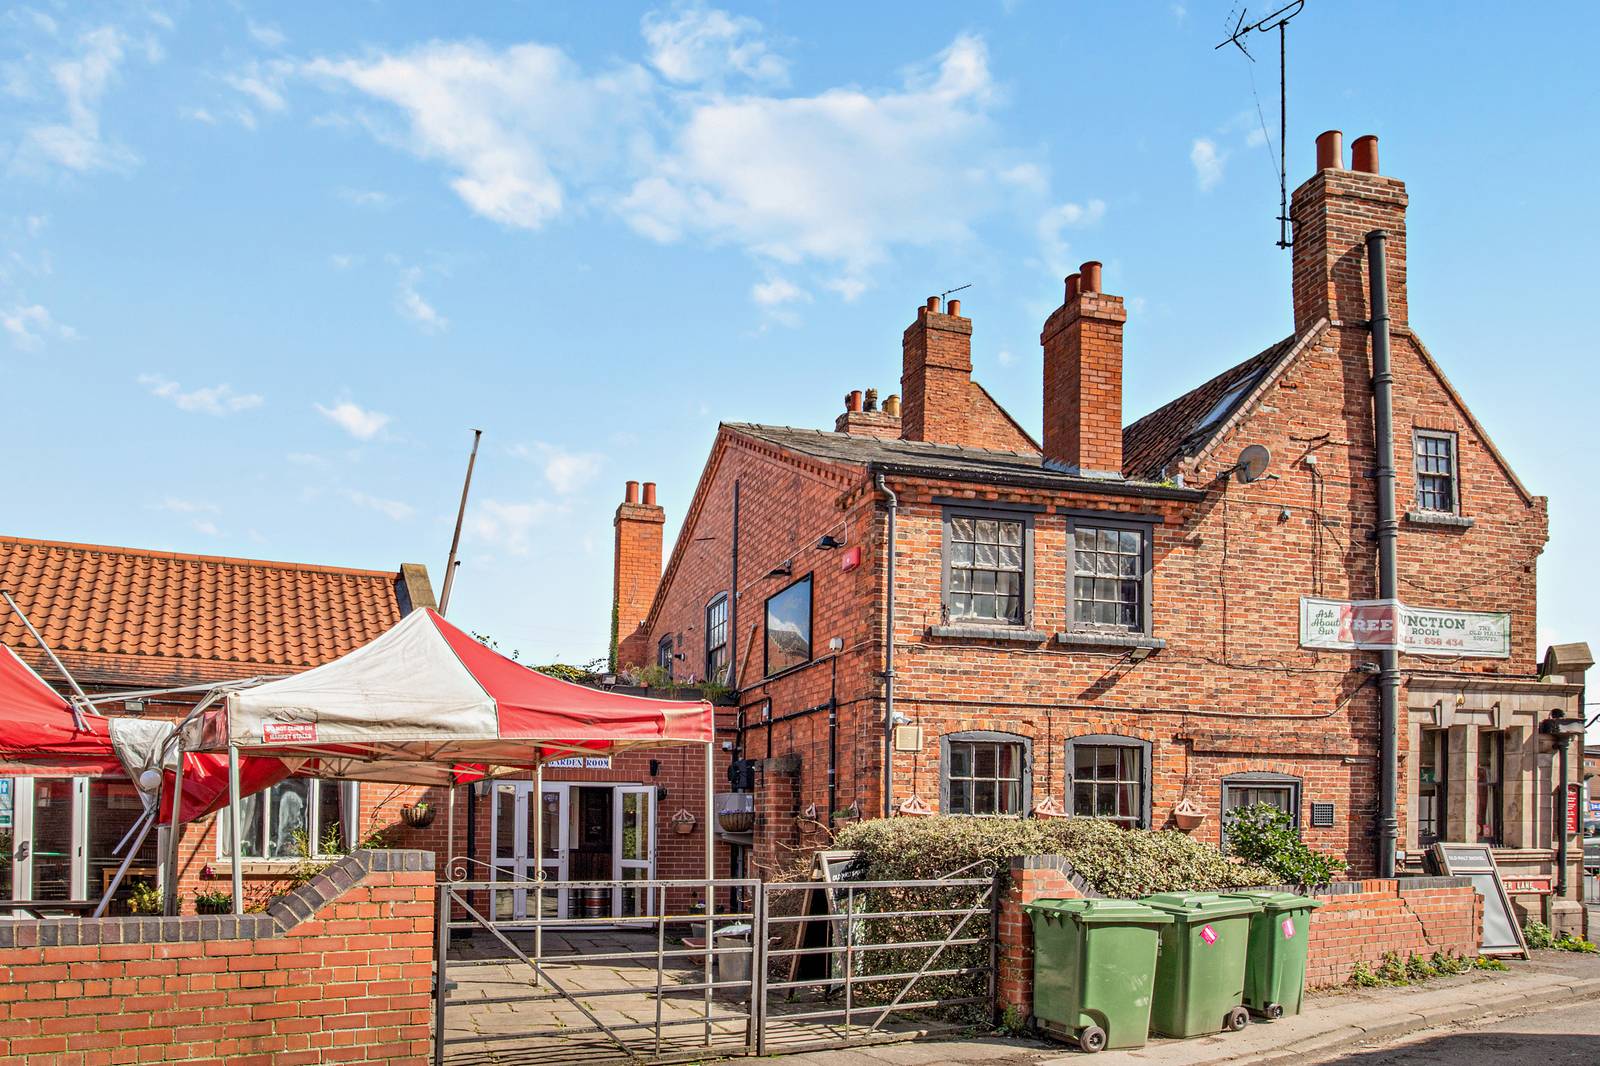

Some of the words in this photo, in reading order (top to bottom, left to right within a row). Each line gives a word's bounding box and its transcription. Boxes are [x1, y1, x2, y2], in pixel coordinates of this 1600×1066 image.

[1315, 609, 1334, 618] Ask
[1311, 618, 1340, 627] About
[1400, 614, 1466, 630] UNCTION
[1318, 626, 1336, 635] Our
[1412, 627, 1440, 636] ROOM
[586, 759, 609, 767] ROOM
[1516, 881, 1533, 890] LANE
